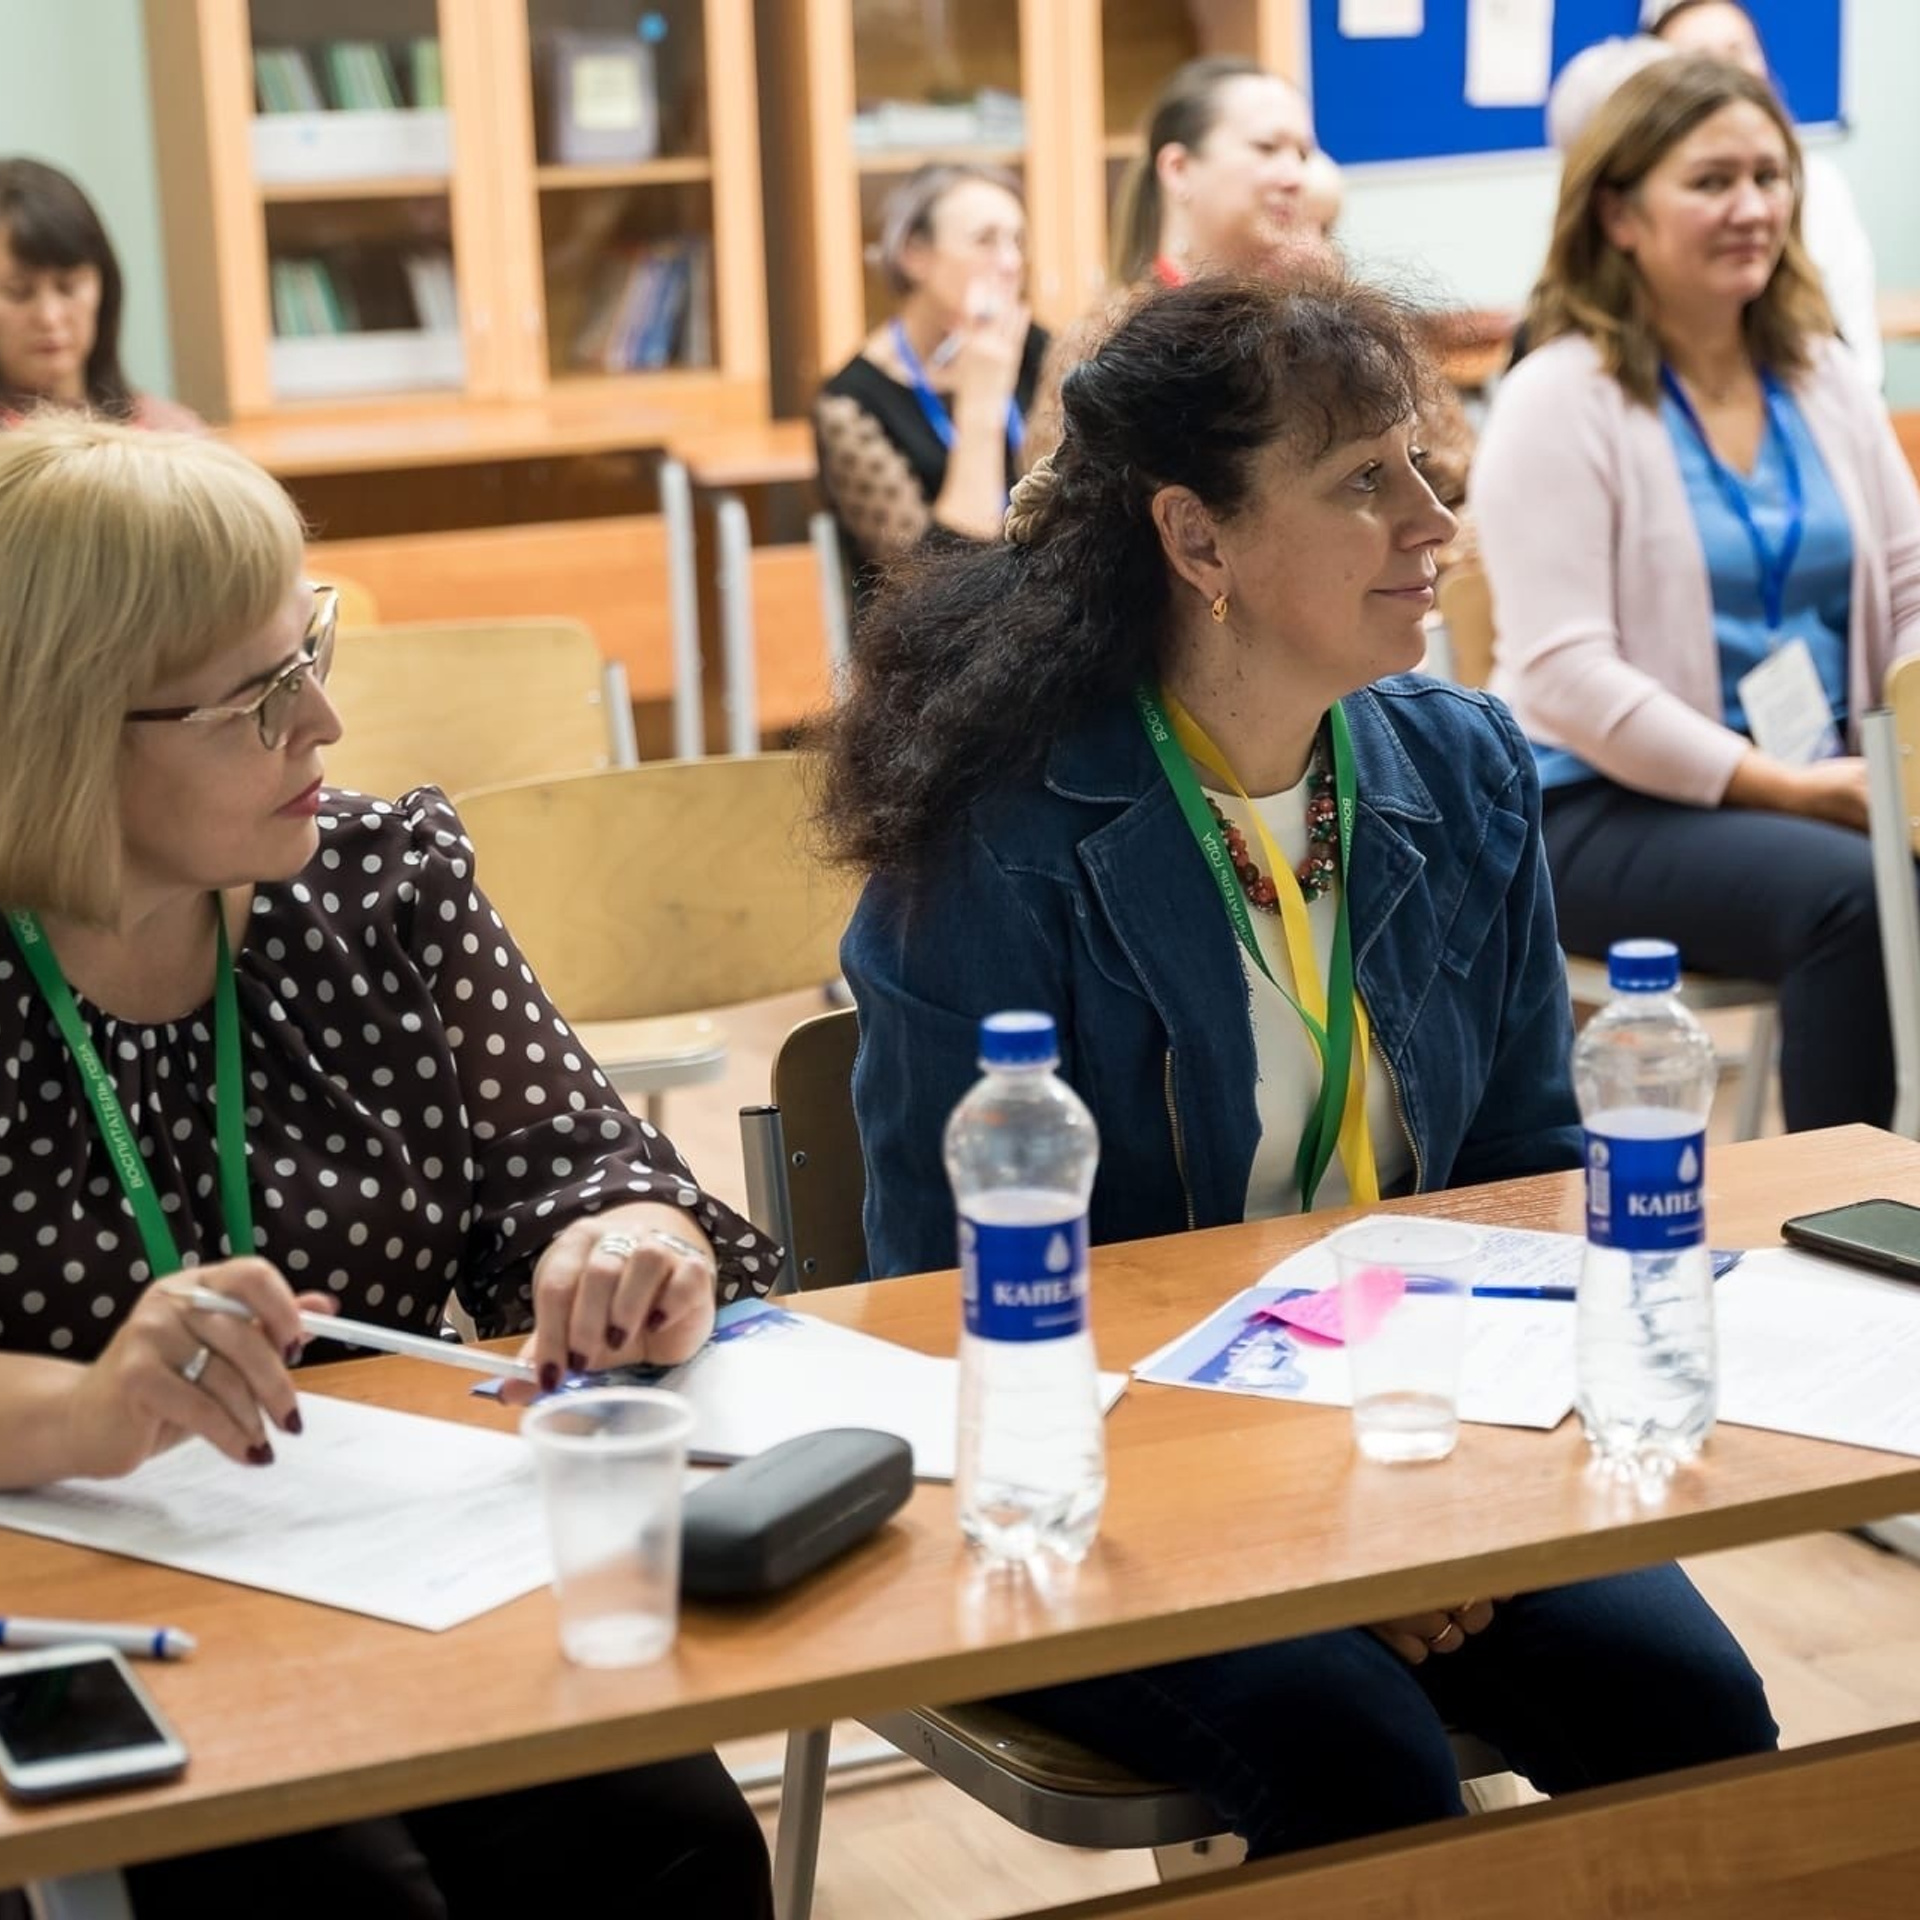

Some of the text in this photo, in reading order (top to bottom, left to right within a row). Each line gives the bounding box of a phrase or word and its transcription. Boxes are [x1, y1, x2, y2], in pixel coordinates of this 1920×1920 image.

[1202, 831, 1226, 868] ГОДА
[78, 1044, 145, 1189] ВОСПИТАТЕЛЬ ГОДА
